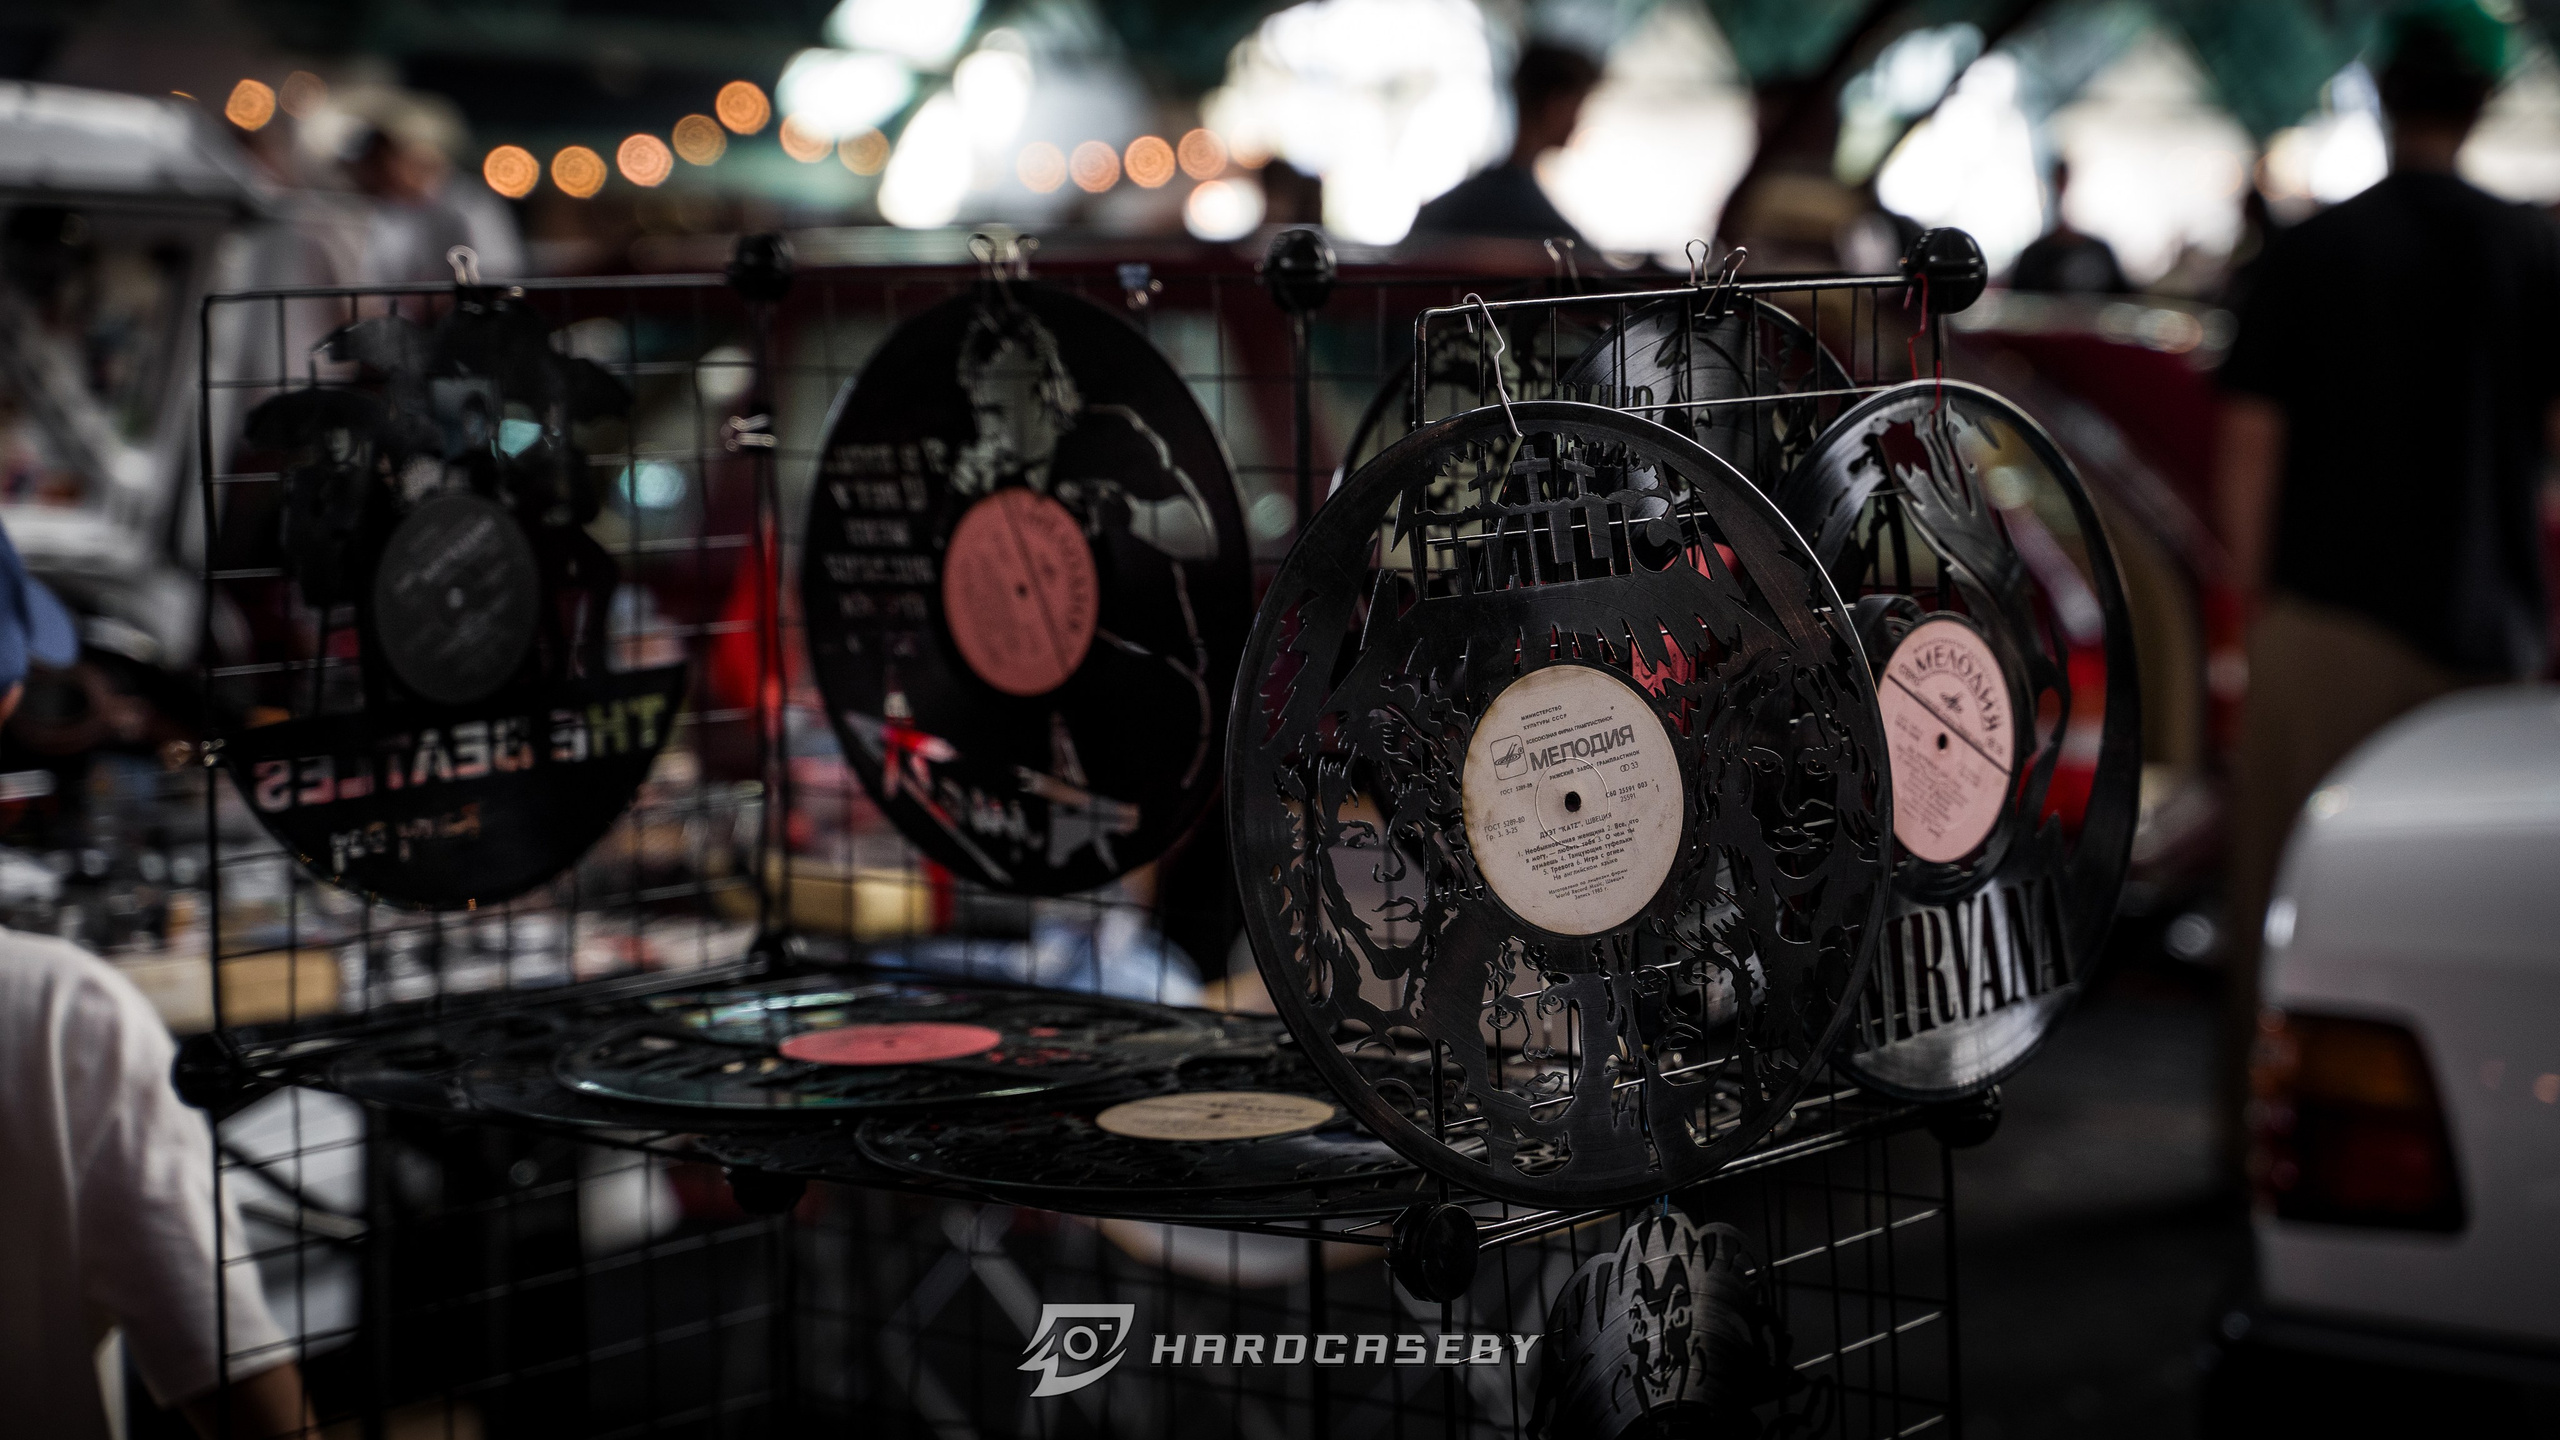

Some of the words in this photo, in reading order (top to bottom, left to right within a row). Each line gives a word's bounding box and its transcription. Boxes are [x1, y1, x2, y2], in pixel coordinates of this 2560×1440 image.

[1521, 705, 1563, 721] МИНИСТЕРСТВО
[1523, 718, 1551, 730] КУЛЬТУРЫ
[1552, 713, 1567, 722] СССР
[1526, 731, 1558, 745] ВСЕСОЮЗНАЯ
[1558, 726, 1575, 736] ФИРМА
[1529, 724, 1636, 772] МЕЛОДИЯ
[1549, 768, 1575, 781] РИЖСКИЙ
[1596, 749, 1641, 766] ГРАМПЛАСТИНОК
[1630, 761, 1639, 770] 33
[1500, 788, 1513, 796] ГОСТ
[1620, 793, 1636, 802] 25591
[1585, 812, 1612, 825] ШВЕЦИЯ
[1484, 822, 1501, 833] ГОСТ
[1577, 827, 1605, 840] женщина
[1628, 818, 1640, 826] что
[1531, 859, 1559, 871] думаешь
[1567, 846, 1603, 860] Танцующие
[1604, 837, 1633, 850] туфельки
[1550, 862, 1575, 874] Тревога
[1583, 854, 1599, 864] Игра
[1606, 847, 1625, 857] огнем
[1563, 864, 1599, 878] английском
[1600, 857, 1619, 867] языке
[1555, 890, 1571, 899] World
[1571, 885, 1588, 894] Record
